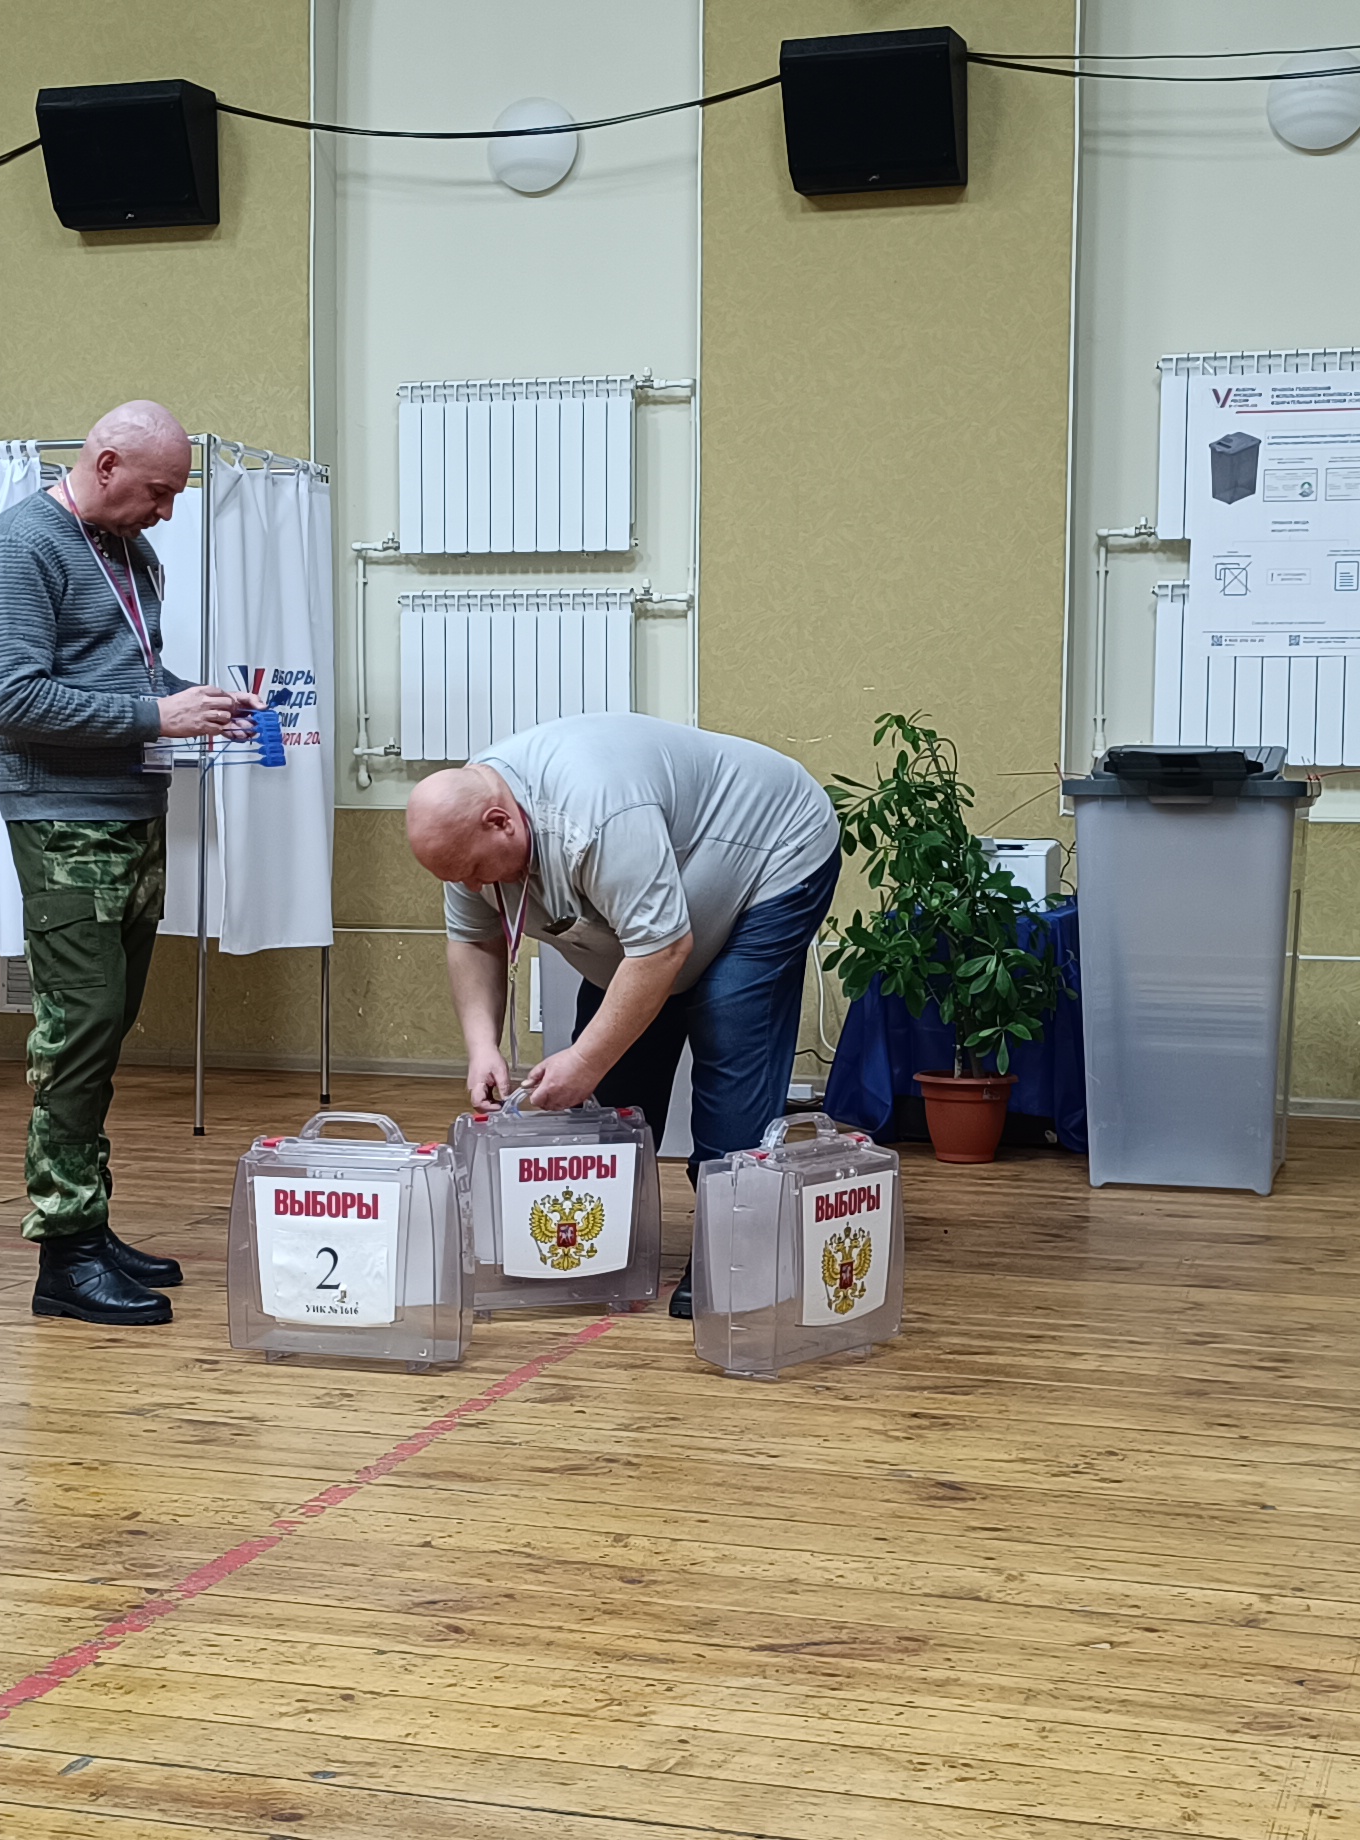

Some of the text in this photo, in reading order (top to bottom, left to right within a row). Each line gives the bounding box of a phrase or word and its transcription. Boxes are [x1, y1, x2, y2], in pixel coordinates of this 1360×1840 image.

[519, 1154, 617, 1183] ВЫБОРЫ
[274, 1188, 379, 1220] ВЫБОРЫ
[814, 1183, 881, 1223] ВЫБОРЫ
[315, 1246, 342, 1290] 2
[305, 1304, 326, 1314] УИК
